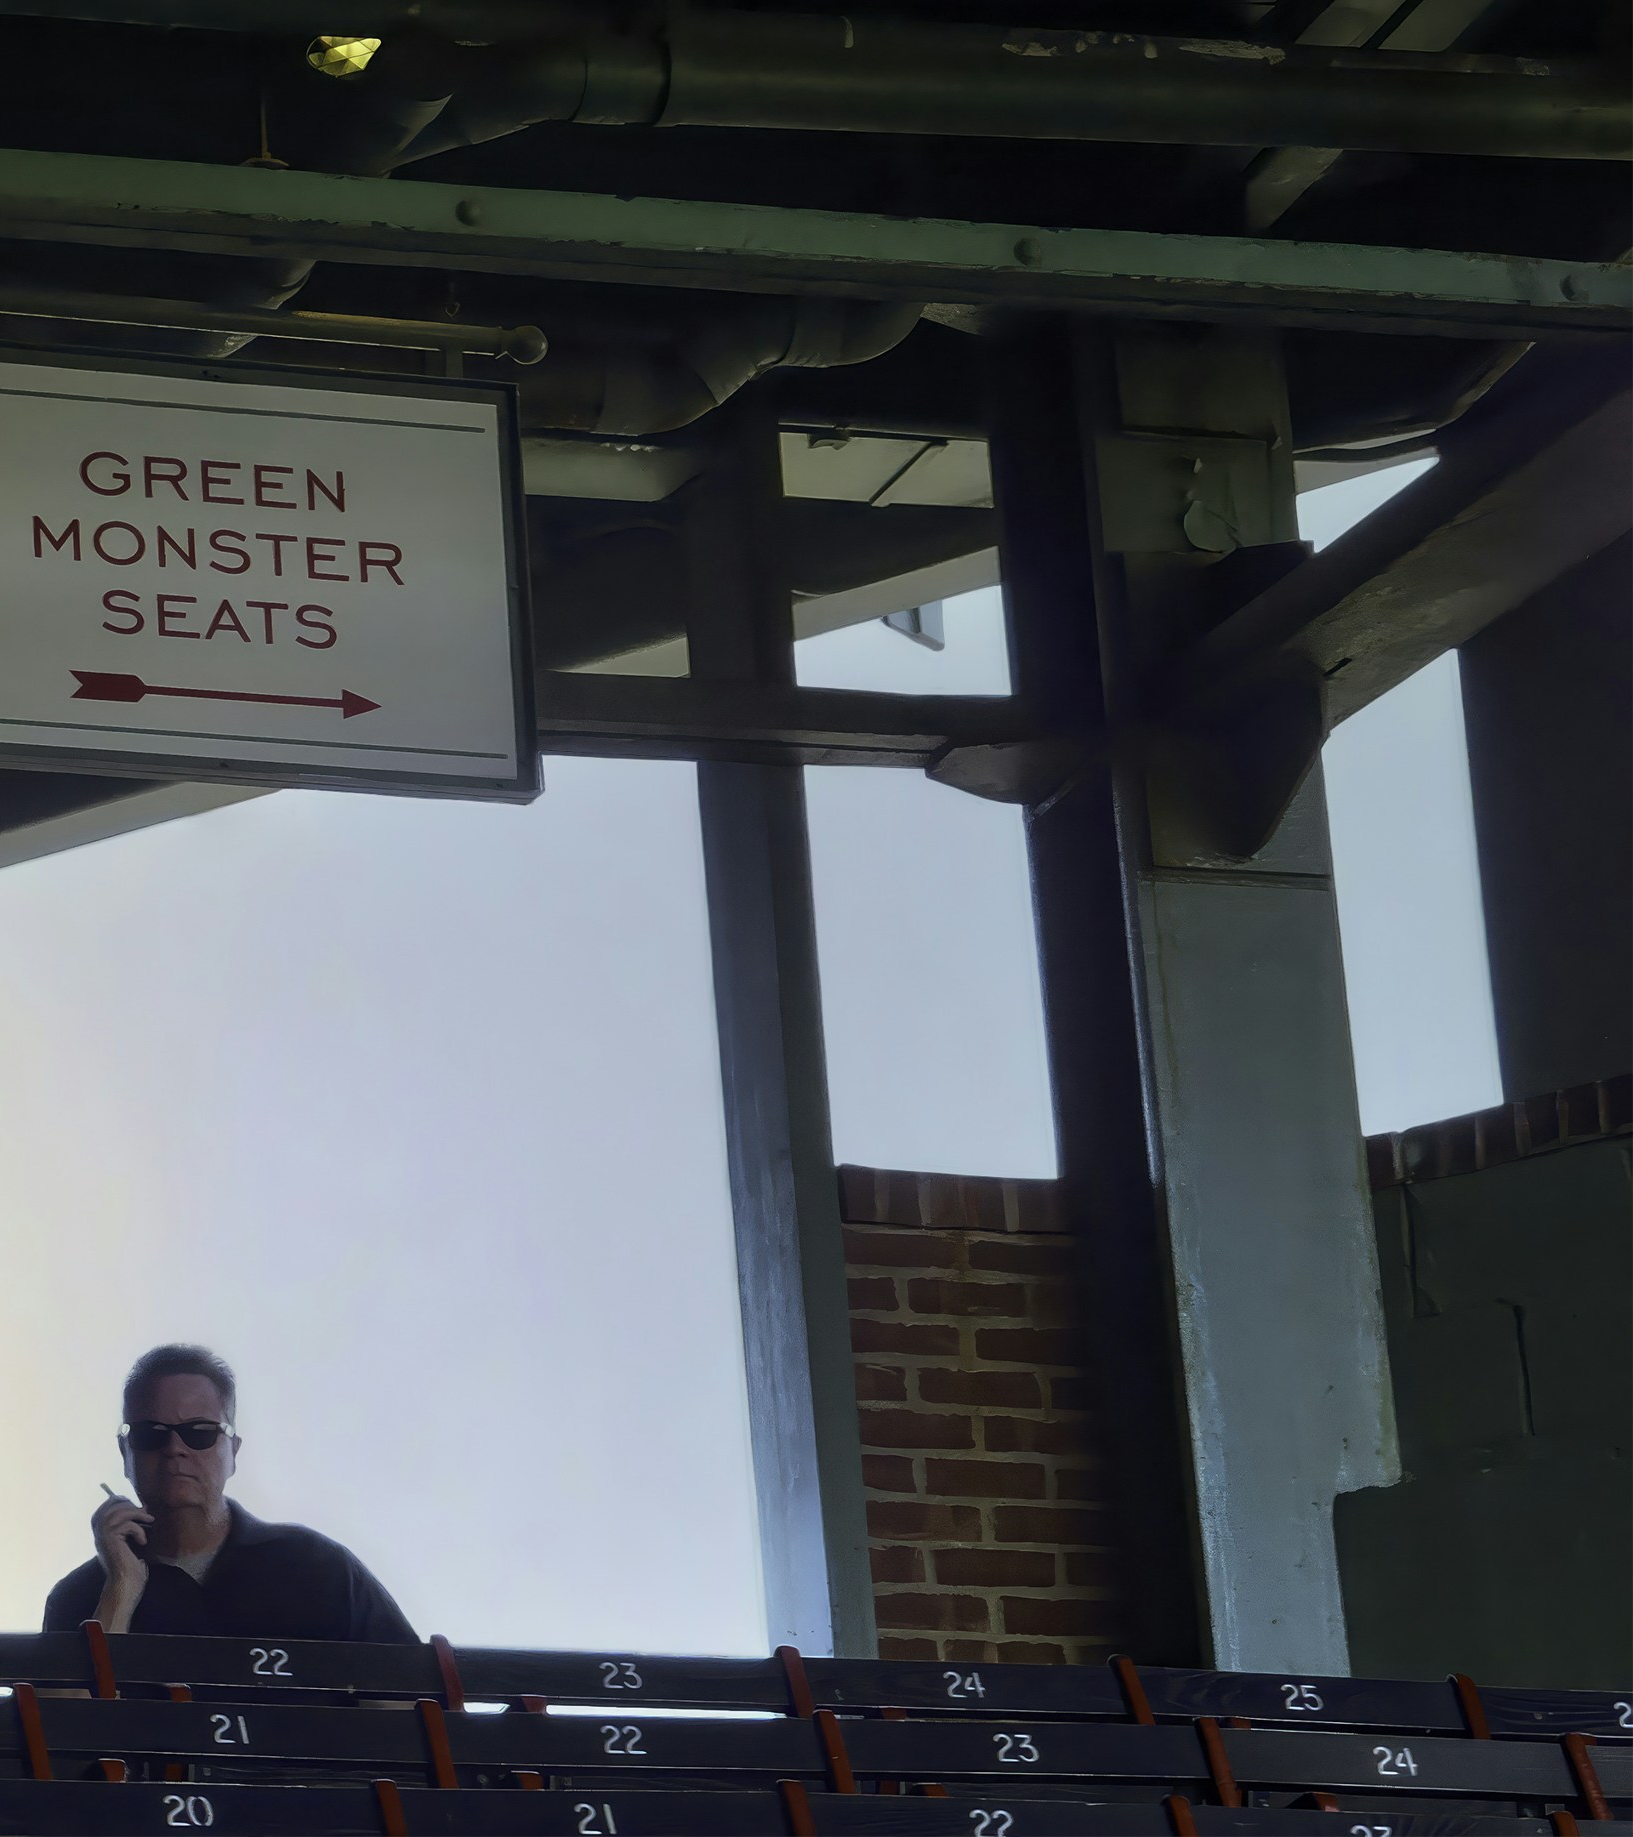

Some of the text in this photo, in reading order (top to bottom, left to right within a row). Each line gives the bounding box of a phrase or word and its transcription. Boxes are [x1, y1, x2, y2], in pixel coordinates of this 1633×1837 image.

[79, 450, 346, 512] GREEN
[31, 515, 405, 586] MONSTER
[102, 589, 338, 650] SEATS
[249, 1647, 293, 1676] 22
[599, 1660, 643, 1689] 23
[942, 1671, 986, 1698] 24
[1280, 1683, 1322, 1711] 25
[210, 1714, 250, 1744] 21
[601, 1725, 647, 1755] 22
[992, 1733, 1039, 1763] 23
[1372, 1746, 1418, 1776] 24
[163, 1794, 214, 1827] 20
[574, 1803, 617, 1835] 21
[969, 1809, 1013, 1837] 22
